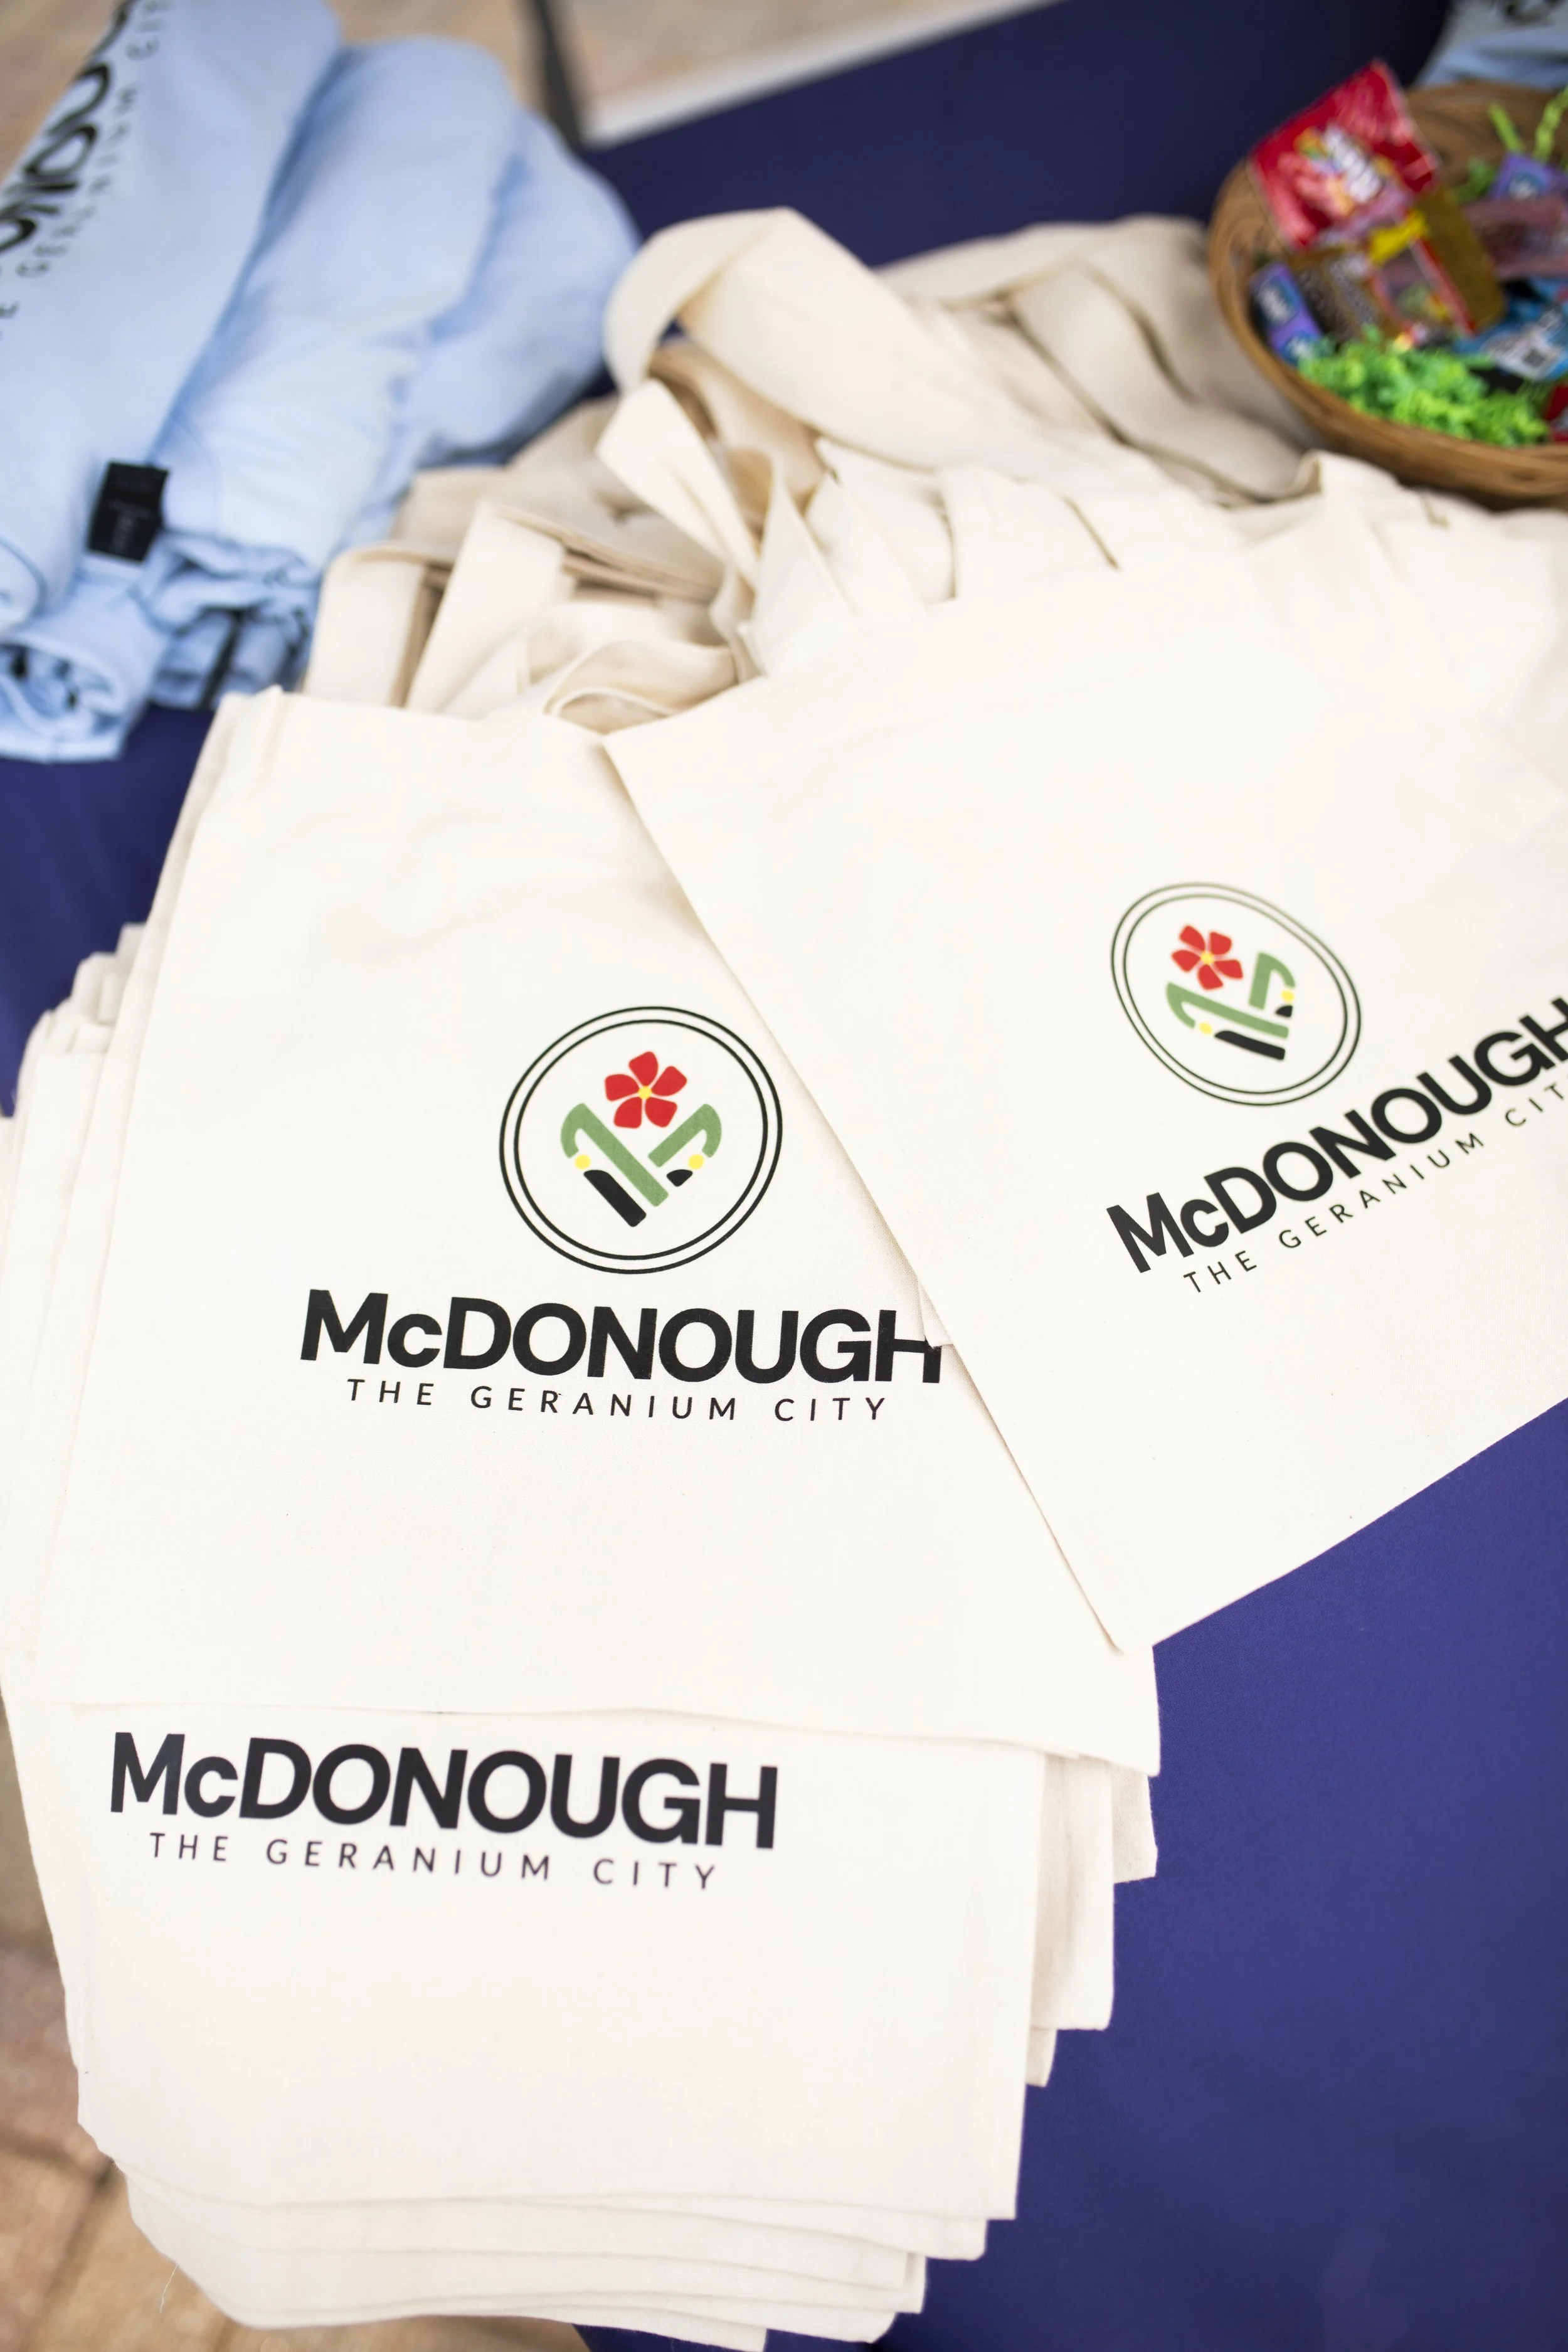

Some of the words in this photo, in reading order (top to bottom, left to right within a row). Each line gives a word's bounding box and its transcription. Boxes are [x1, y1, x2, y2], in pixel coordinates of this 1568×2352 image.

[1105, 996, 1568, 1274] McDONOUGH
[1182, 1249, 1258, 1293] THE
[1278, 1131, 1485, 1249] GERANIUM
[1504, 1074, 1568, 1128] CIT
[299, 1288, 943, 1385] McDONOUGH
[346, 1378, 435, 1406] THE
[470, 1385, 736, 1421] GERANIUM
[774, 1396, 886, 1422] CITY
[110, 1731, 778, 1850] McDONOUGH
[149, 1831, 230, 1862] THE
[265, 1838, 550, 1880] GERANIUM
[593, 1857, 715, 1890] CITY
